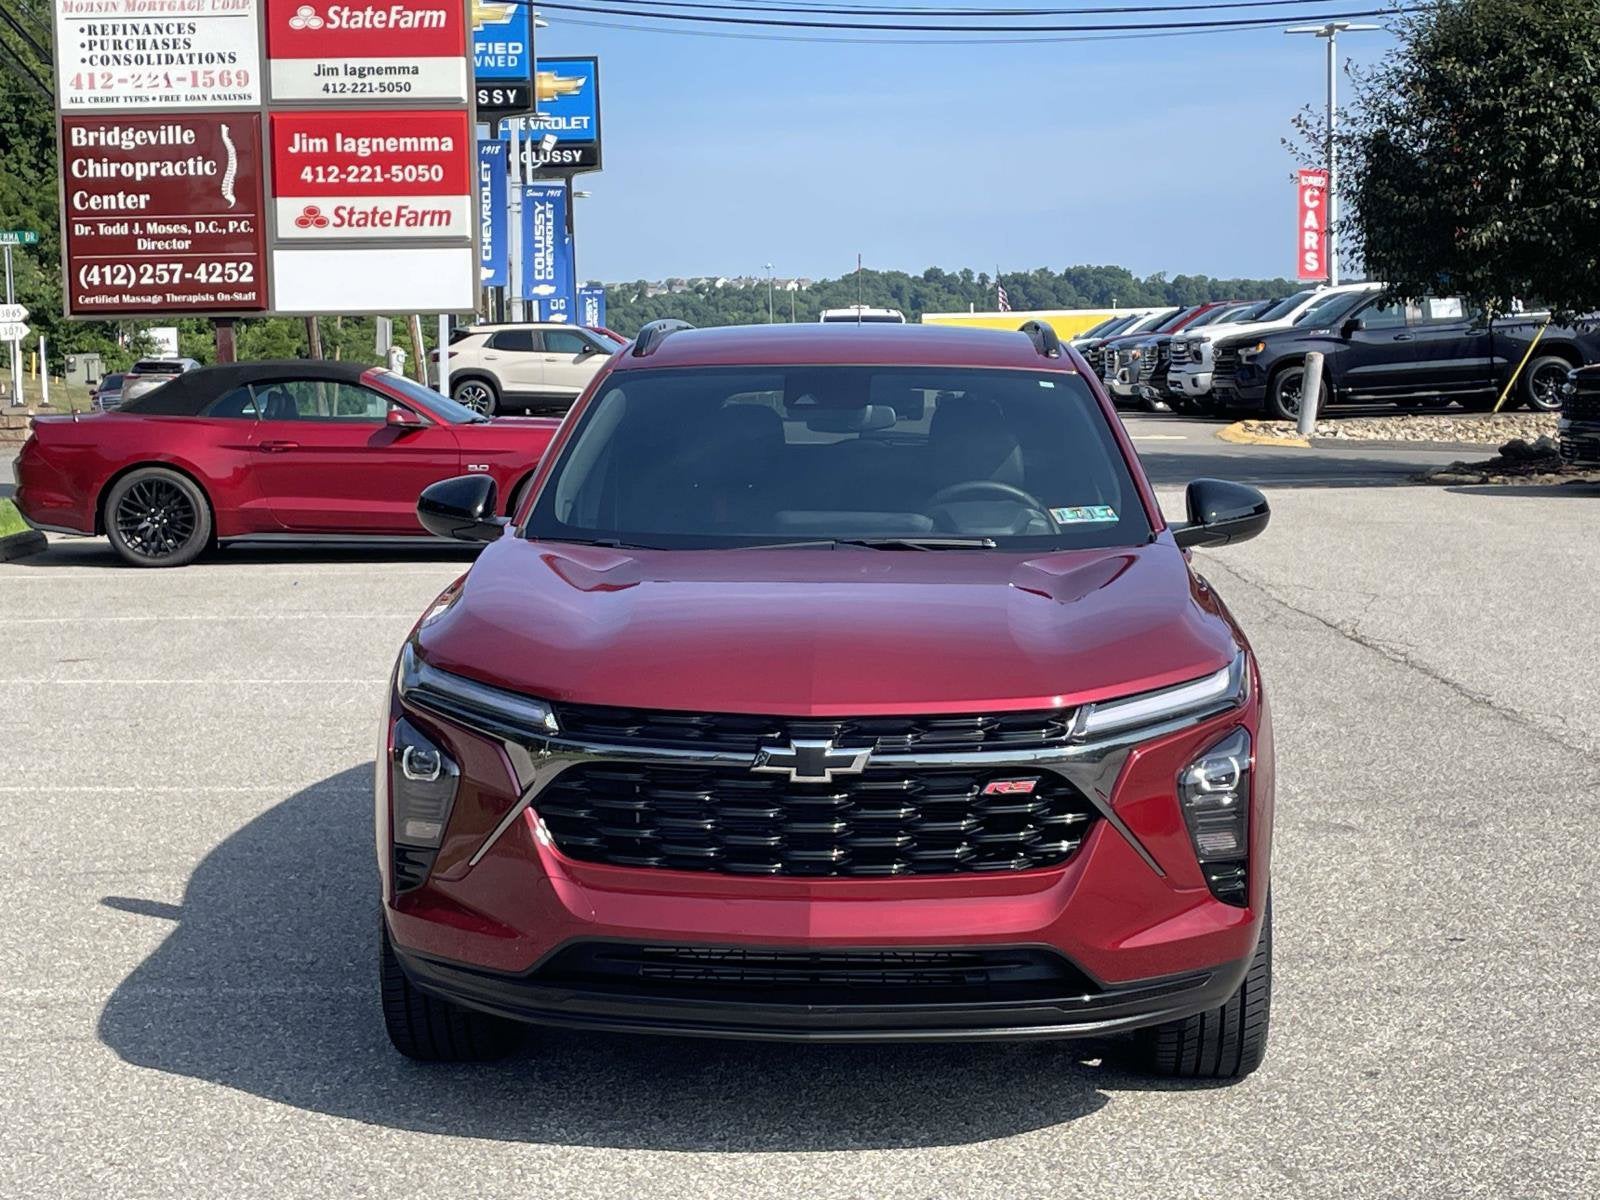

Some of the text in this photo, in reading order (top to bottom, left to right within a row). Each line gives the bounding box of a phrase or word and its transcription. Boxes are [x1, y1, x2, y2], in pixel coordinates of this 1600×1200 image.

[124, 0, 204, 12] MORTGAGE
[69, 70, 250, 90] 412-221-1569
[313, 63, 420, 79] Jim Iagnemma
[322, 82, 412, 94] 412-221-5050
[478, 89, 517, 104] SSY
[123, 95, 150, 103] TYPES
[159, 94, 181, 102] FREE
[210, 93, 252, 101] ANALYSIS
[71, 125, 196, 150] Bridgeville
[288, 132, 454, 157] Jim Iagnemma
[71, 156, 217, 182] Chiropractic
[300, 164, 444, 183] 412-221-5050
[72, 190, 150, 211] Center
[481, 160, 492, 261] CHEVROLET
[74, 223, 95, 236] Dr.
[97, 222, 129, 236] Todd
[132, 222, 143, 235] J.
[146, 222, 192, 236] Moses,
[1303, 187, 1321, 272] CARS
[137, 238, 192, 250] Director
[534, 201, 545, 280] COLUSSY
[545, 201, 554, 280] CHEVROLET
[78, 291, 257, 304] Certified Massage Therapists On-Staff
